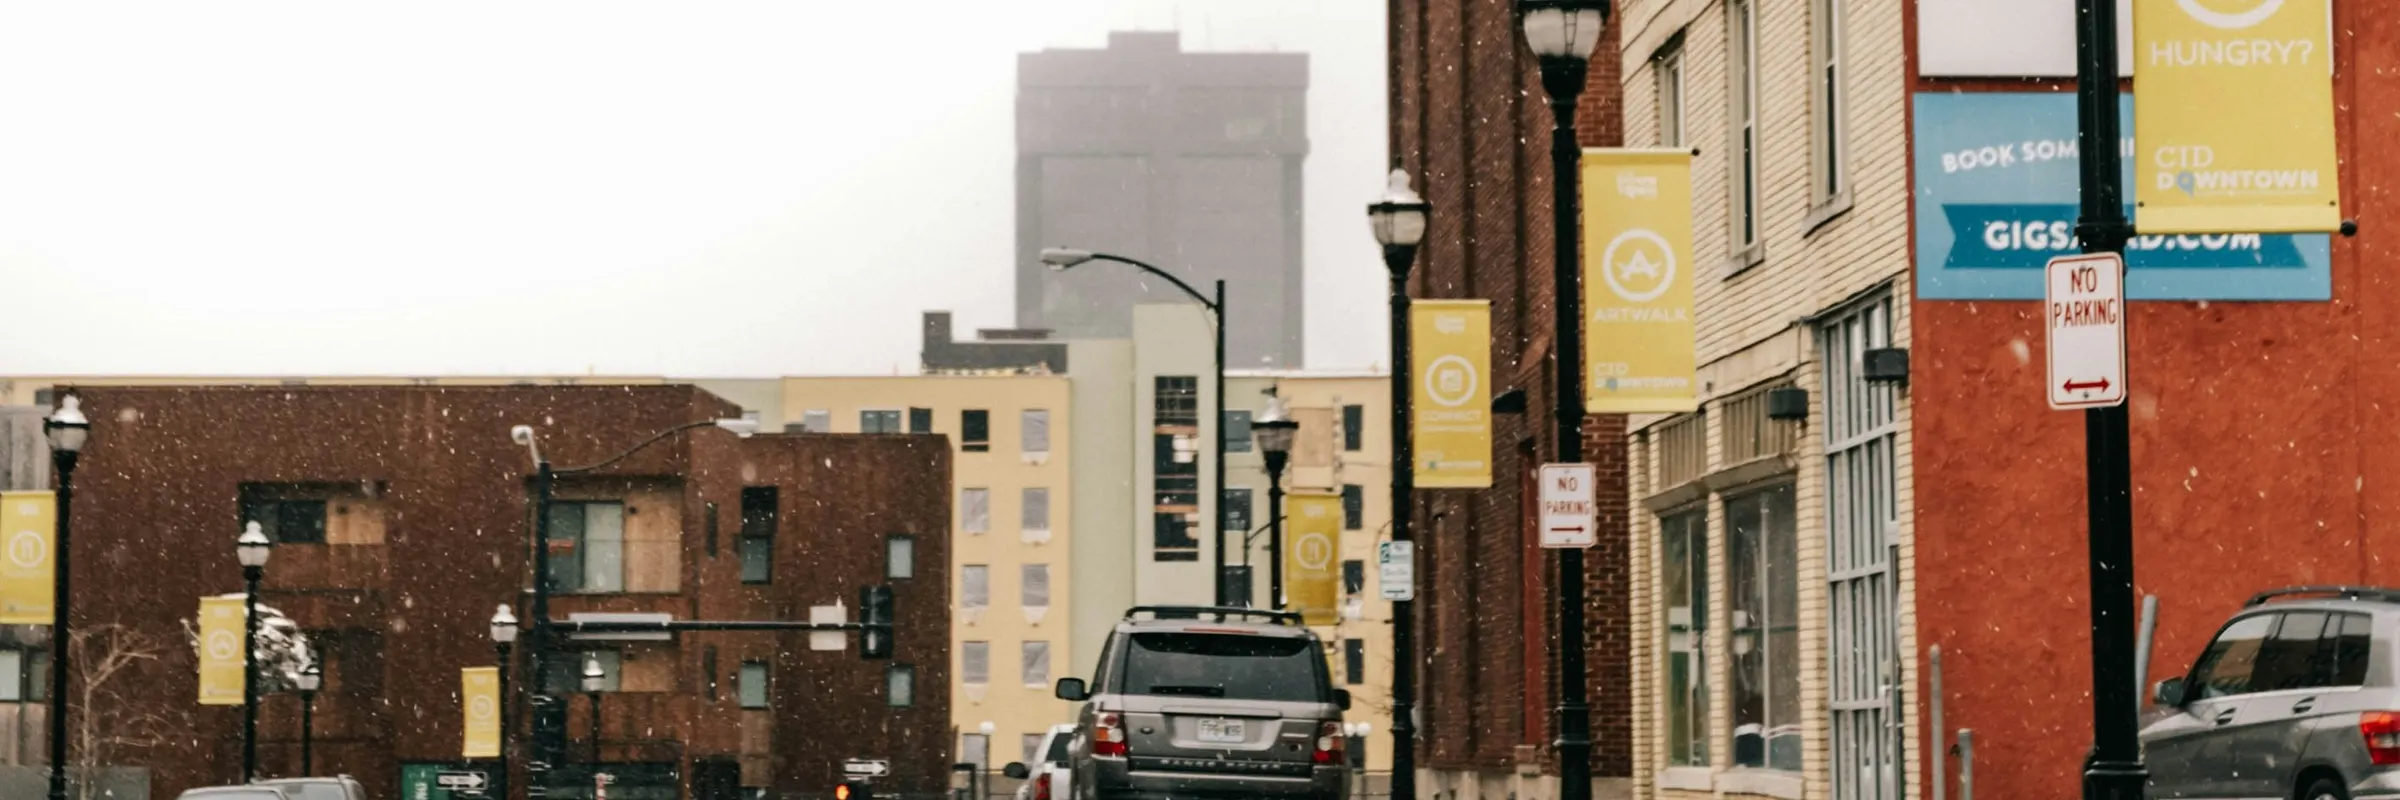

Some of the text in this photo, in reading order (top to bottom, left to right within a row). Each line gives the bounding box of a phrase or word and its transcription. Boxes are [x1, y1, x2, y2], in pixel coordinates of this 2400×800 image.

[2151, 39, 2314, 67] HUNGRY?
[1942, 143, 2015, 174] BOOK
[2155, 145, 2214, 169] CID
[2156, 170, 2319, 197] DOWNTOWN
[2070, 267, 2097, 294] NO
[1593, 307, 1688, 322] ARTWALK
[2053, 299, 2116, 328] PARKING
[1557, 476, 1578, 493] NO
